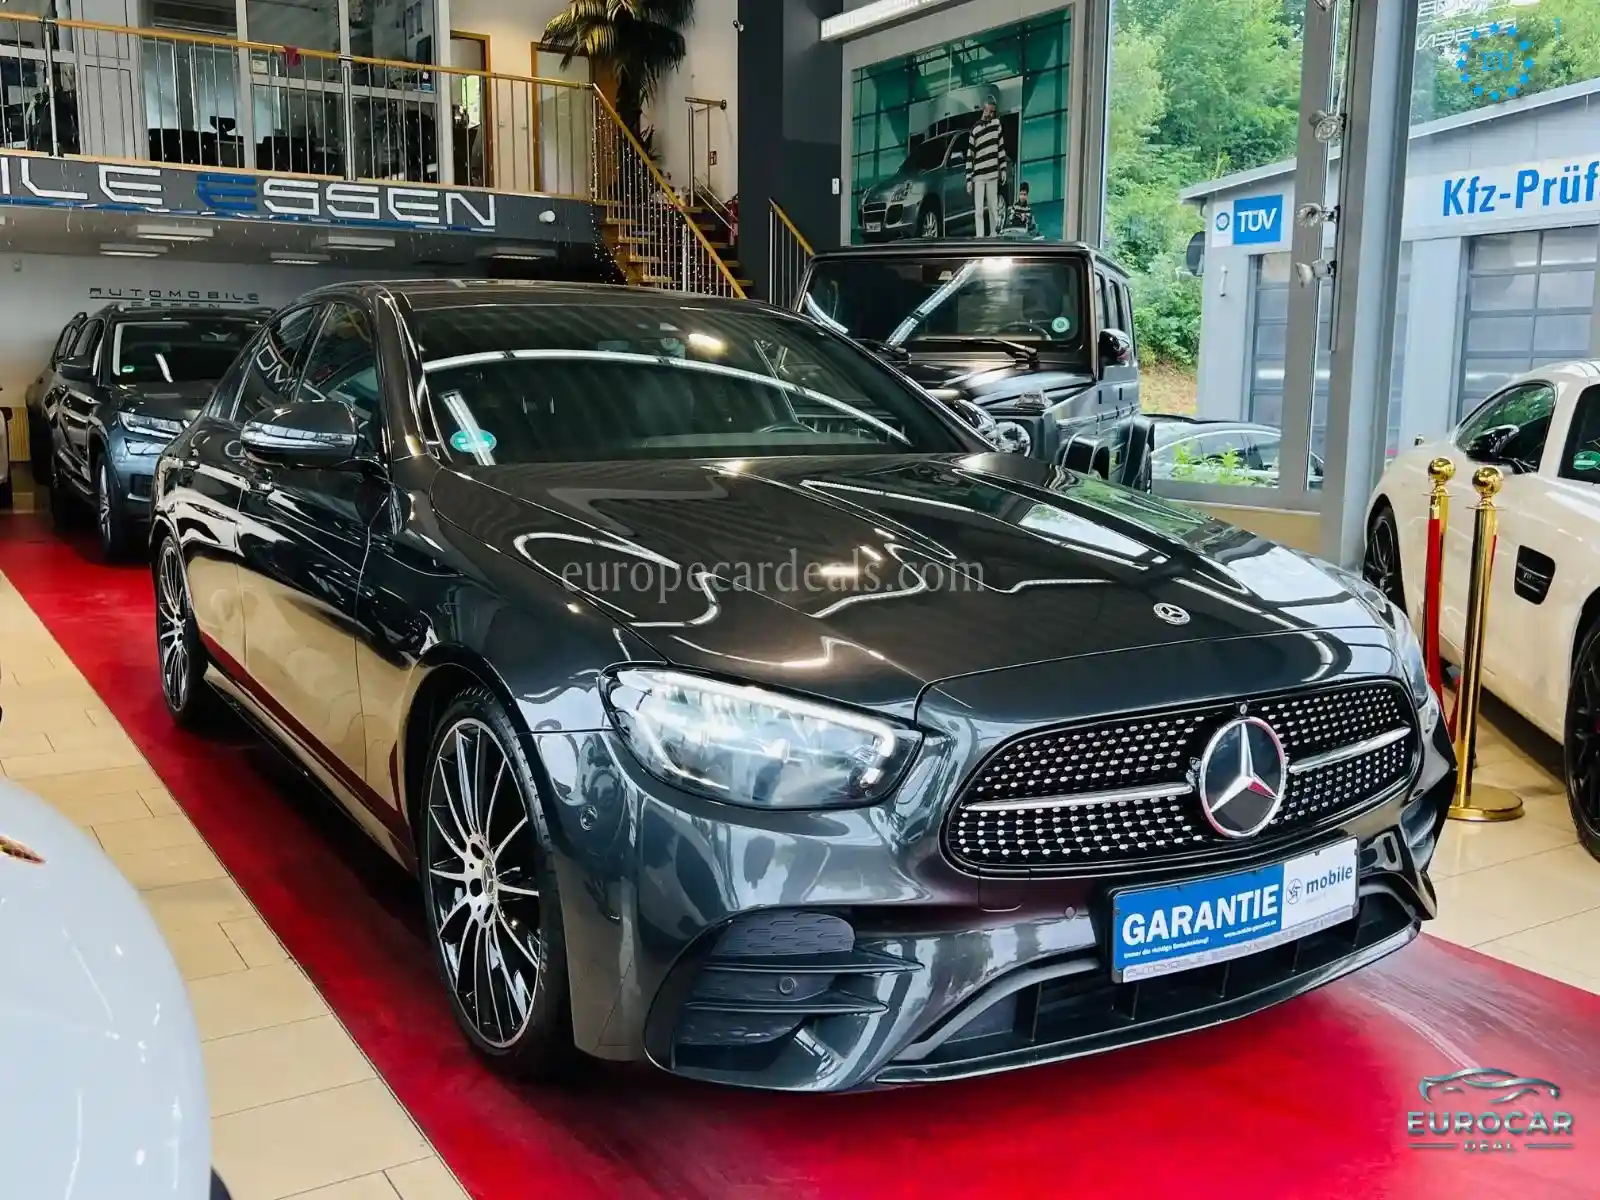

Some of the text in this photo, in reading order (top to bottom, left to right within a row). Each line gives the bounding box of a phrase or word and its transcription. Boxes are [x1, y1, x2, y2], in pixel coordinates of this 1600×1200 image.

[197, 172, 496, 227] ESSEN
[1236, 206, 1278, 233] TÜV
[89, 287, 260, 302] AUTOMOBILE
[1122, 884, 1280, 946] GARANTIE
[1306, 866, 1353, 894] mobile
